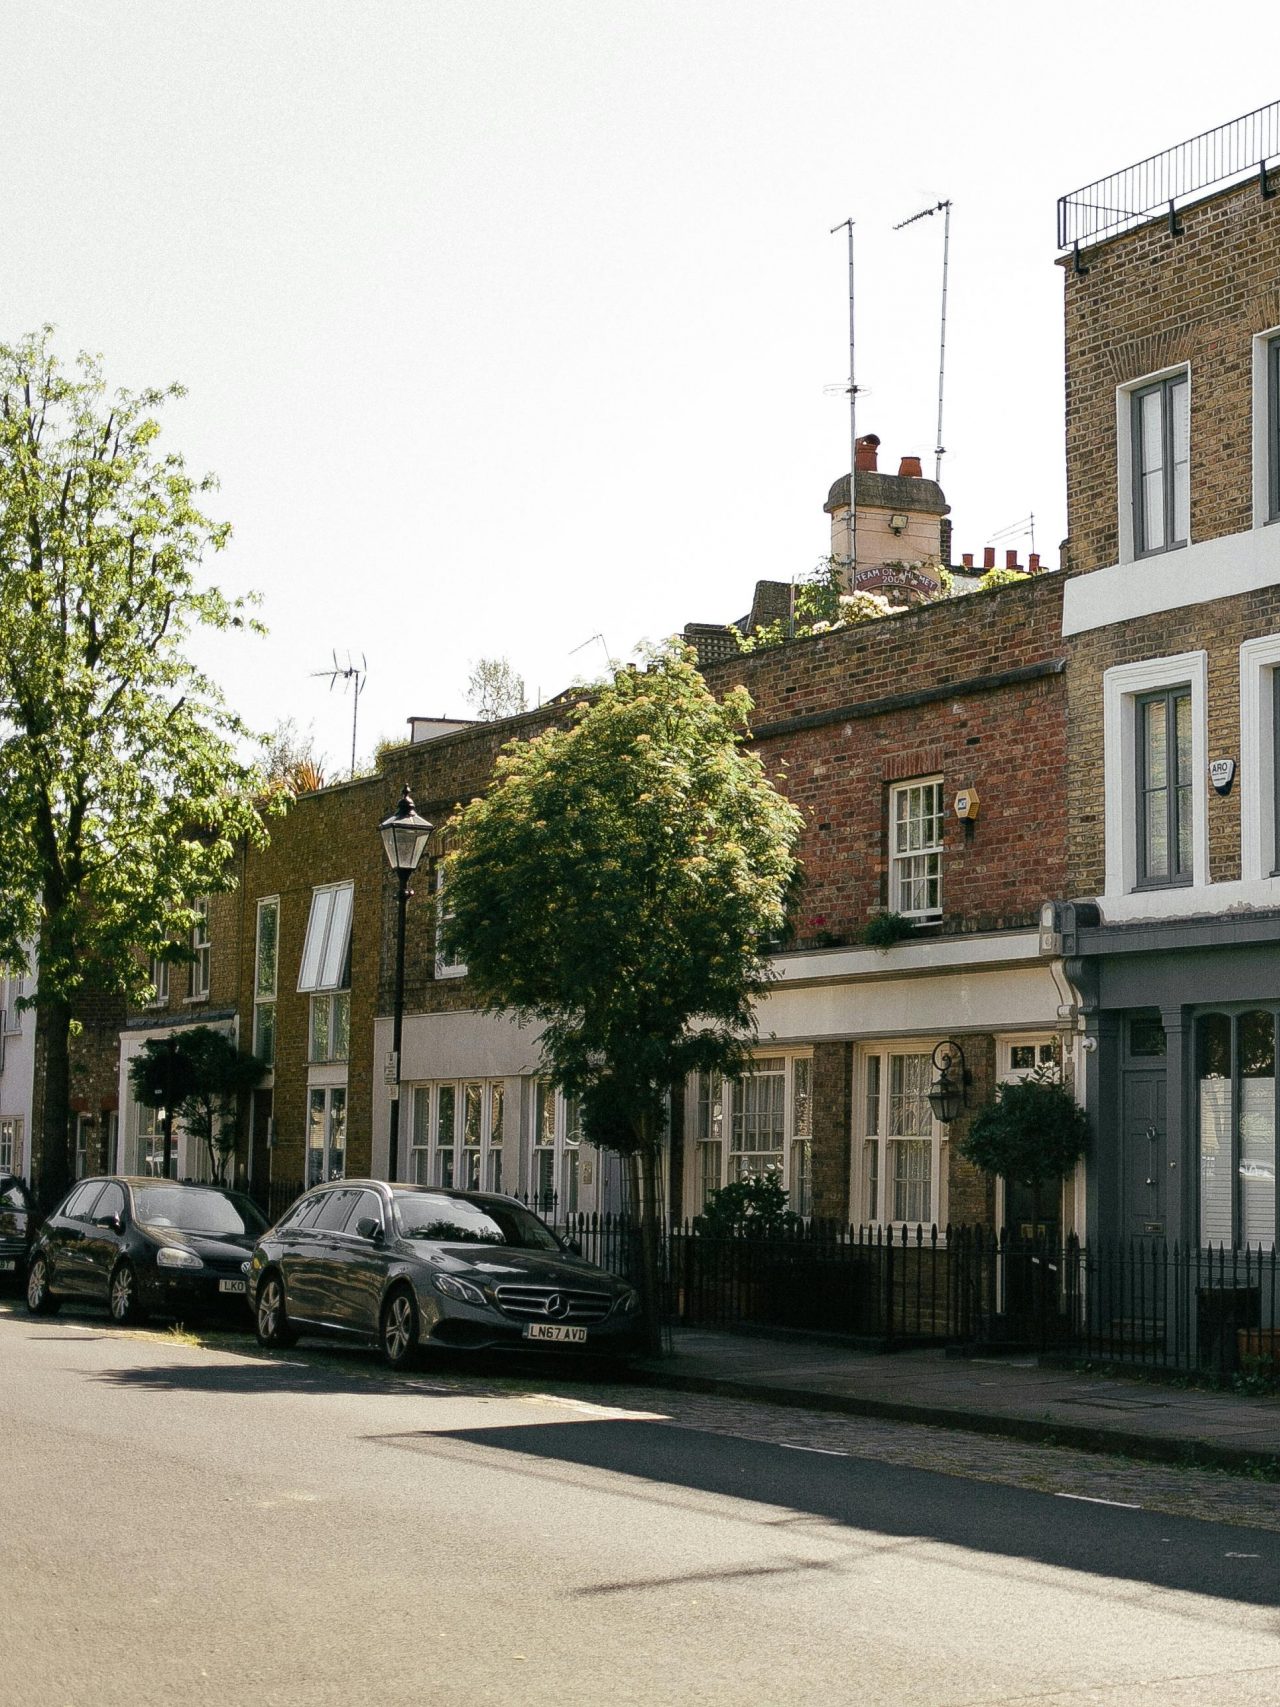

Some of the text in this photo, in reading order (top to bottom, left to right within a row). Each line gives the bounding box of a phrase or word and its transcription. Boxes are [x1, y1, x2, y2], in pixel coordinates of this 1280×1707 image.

[855, 569, 880, 584] TEAM
[882, 568, 896, 576] ON
[920, 575, 936, 588] MET
[1212, 763, 1228, 772] ARO
[530, 1326, 585, 1340] LN67 AVD
